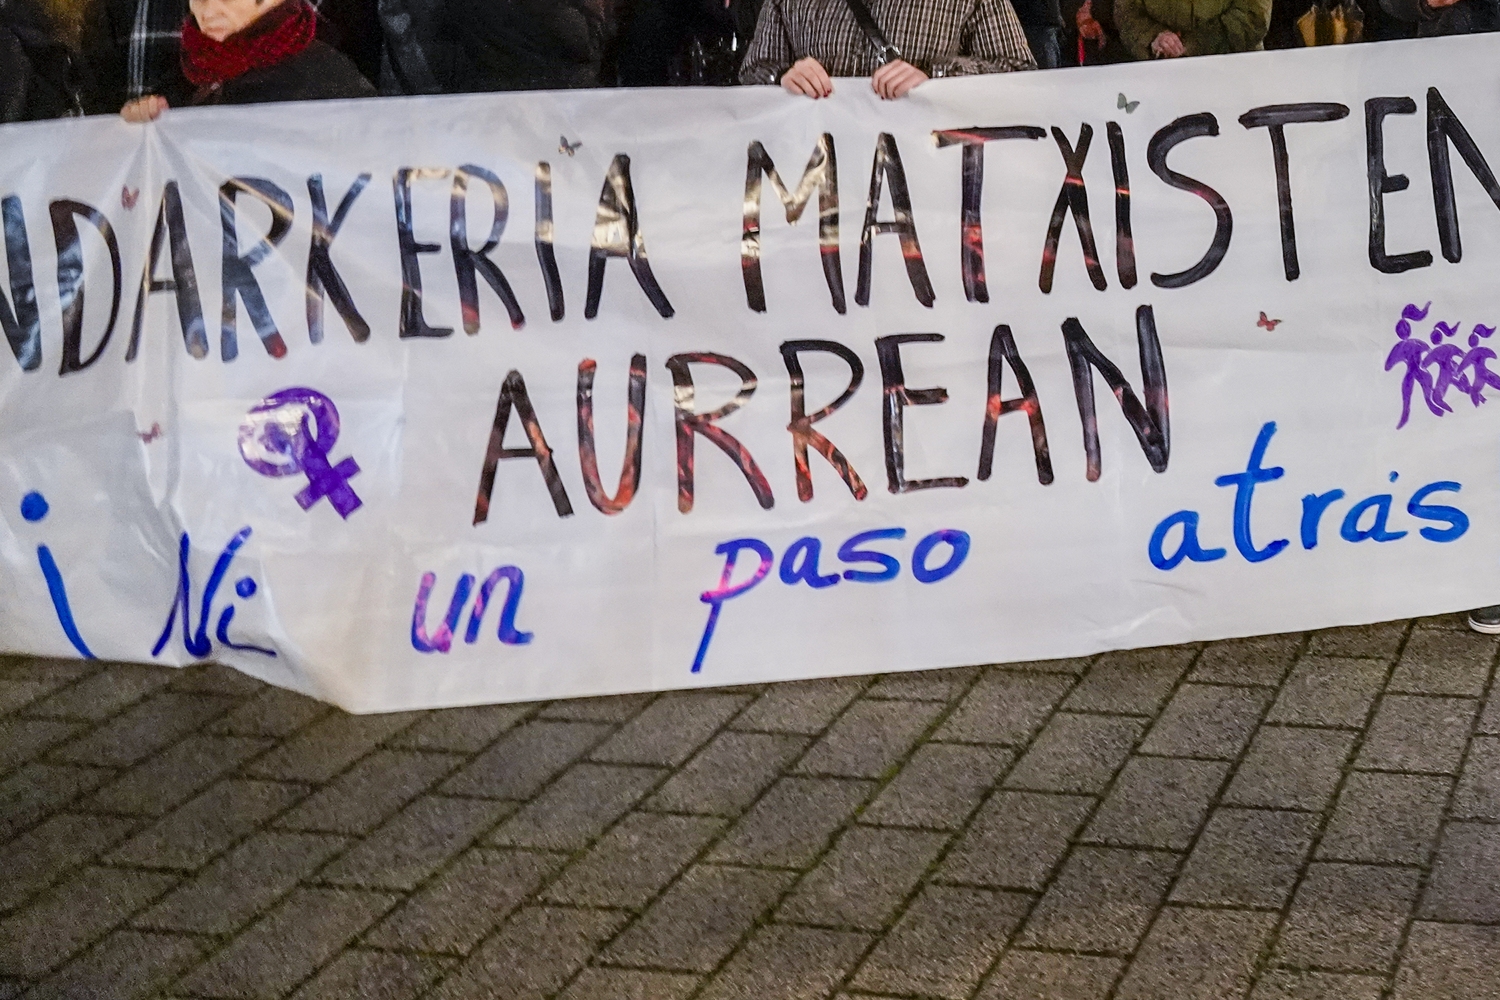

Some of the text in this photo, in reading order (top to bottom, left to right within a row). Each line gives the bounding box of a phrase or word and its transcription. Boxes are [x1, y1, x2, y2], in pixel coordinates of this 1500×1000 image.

[473, 304, 1169, 526] AURREAN
[410, 564, 535, 654] un
[690, 526, 971, 673] paso
